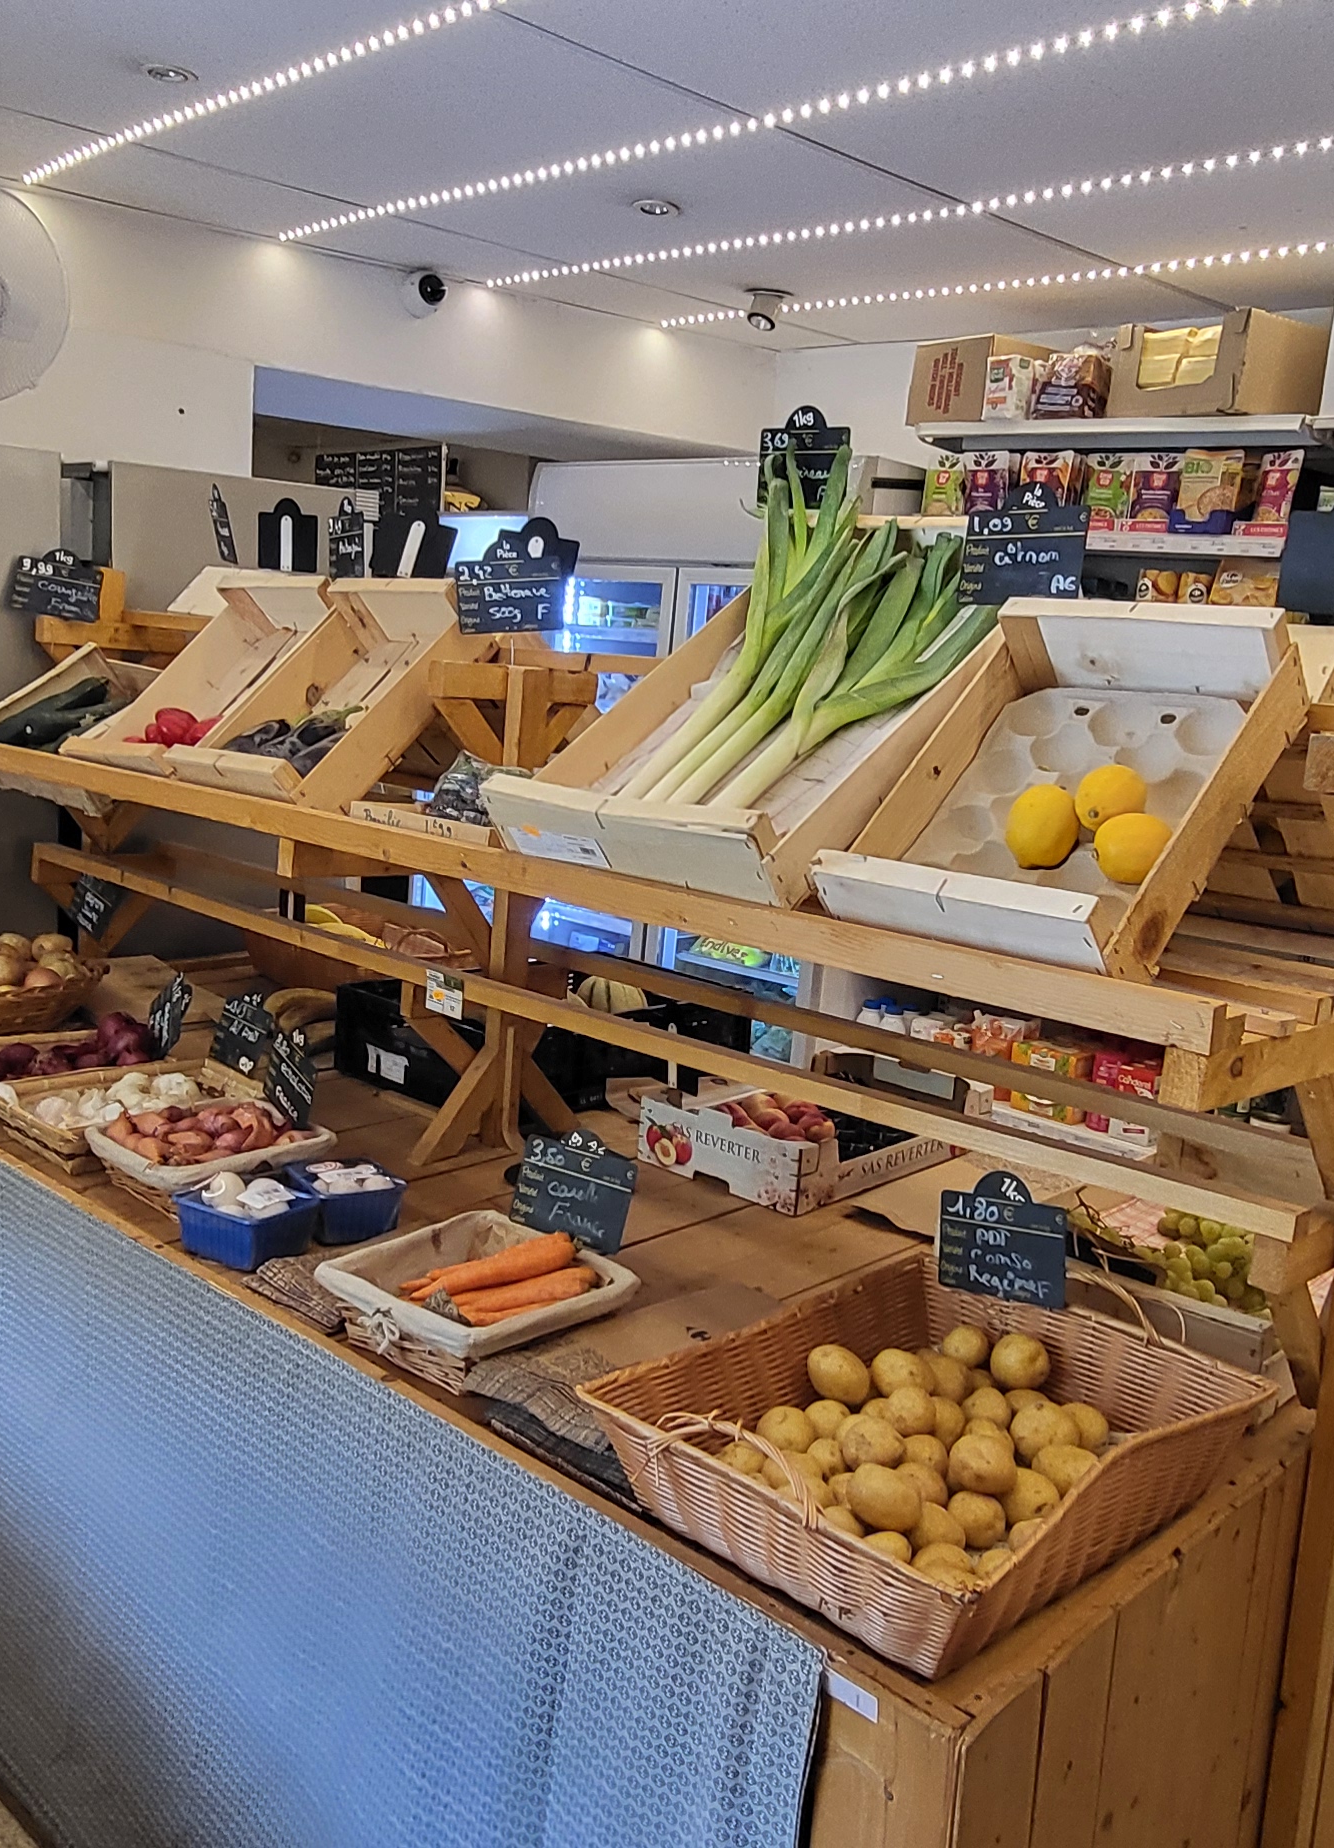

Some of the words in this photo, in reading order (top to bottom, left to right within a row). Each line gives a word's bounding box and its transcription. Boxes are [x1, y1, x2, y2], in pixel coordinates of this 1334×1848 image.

[792, 410, 814, 428] 1kg
[1183, 460, 1213, 475] BIO
[972, 515, 1013, 535] 1,09
[54, 550, 74, 565] 1kg
[458, 565, 493, 585] 2,42
[536, 603, 551, 620] F
[671, 1120, 693, 1140] SAS
[694, 1129, 762, 1165] REVERTER
[859, 1157, 883, 1179] SAS
[885, 1139, 946, 1171] REVERTER
[946, 1194, 1000, 1223] 1,80
[975, 1227, 1012, 1247] PDT
